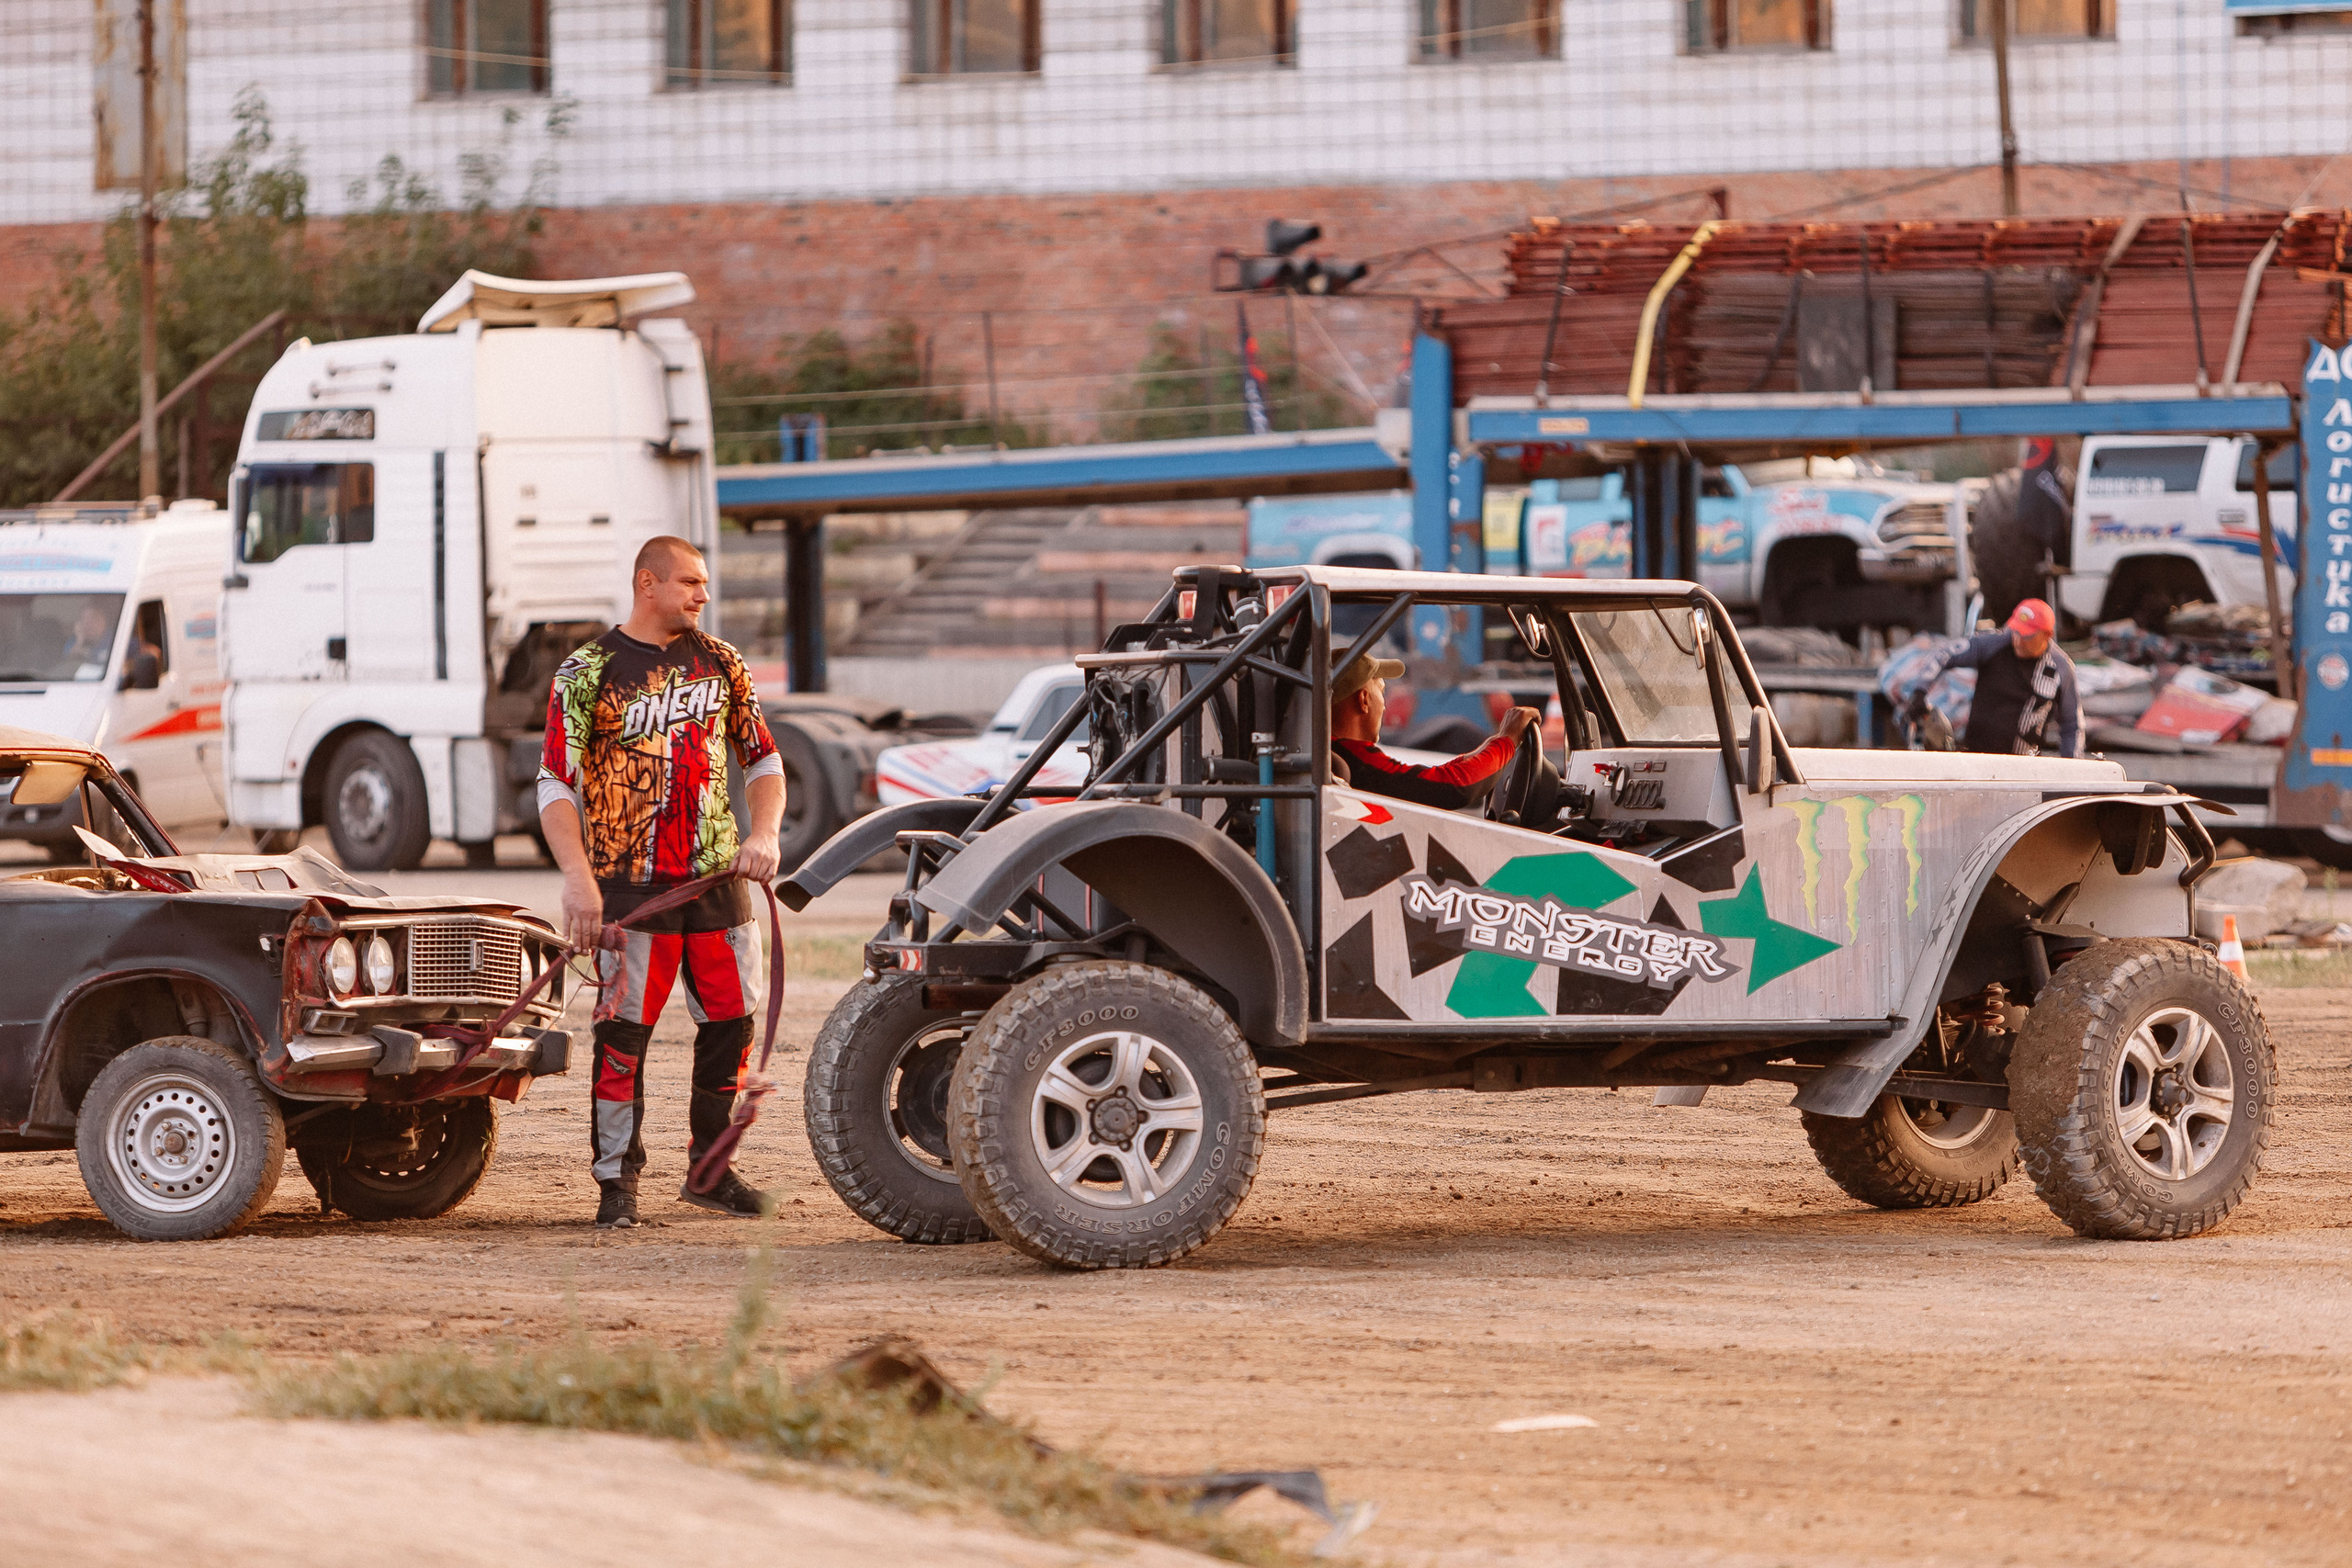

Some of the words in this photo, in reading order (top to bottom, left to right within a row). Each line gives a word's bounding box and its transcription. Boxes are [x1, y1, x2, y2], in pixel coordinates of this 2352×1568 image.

[1409, 879, 1726, 977] MONSTER
[1470, 922, 1683, 983] ENERGY
[1023, 1005, 1139, 1072] CF3000
[2217, 1001, 2259, 1119] CF3000
[1054, 1121, 1232, 1235] COMFORSER
